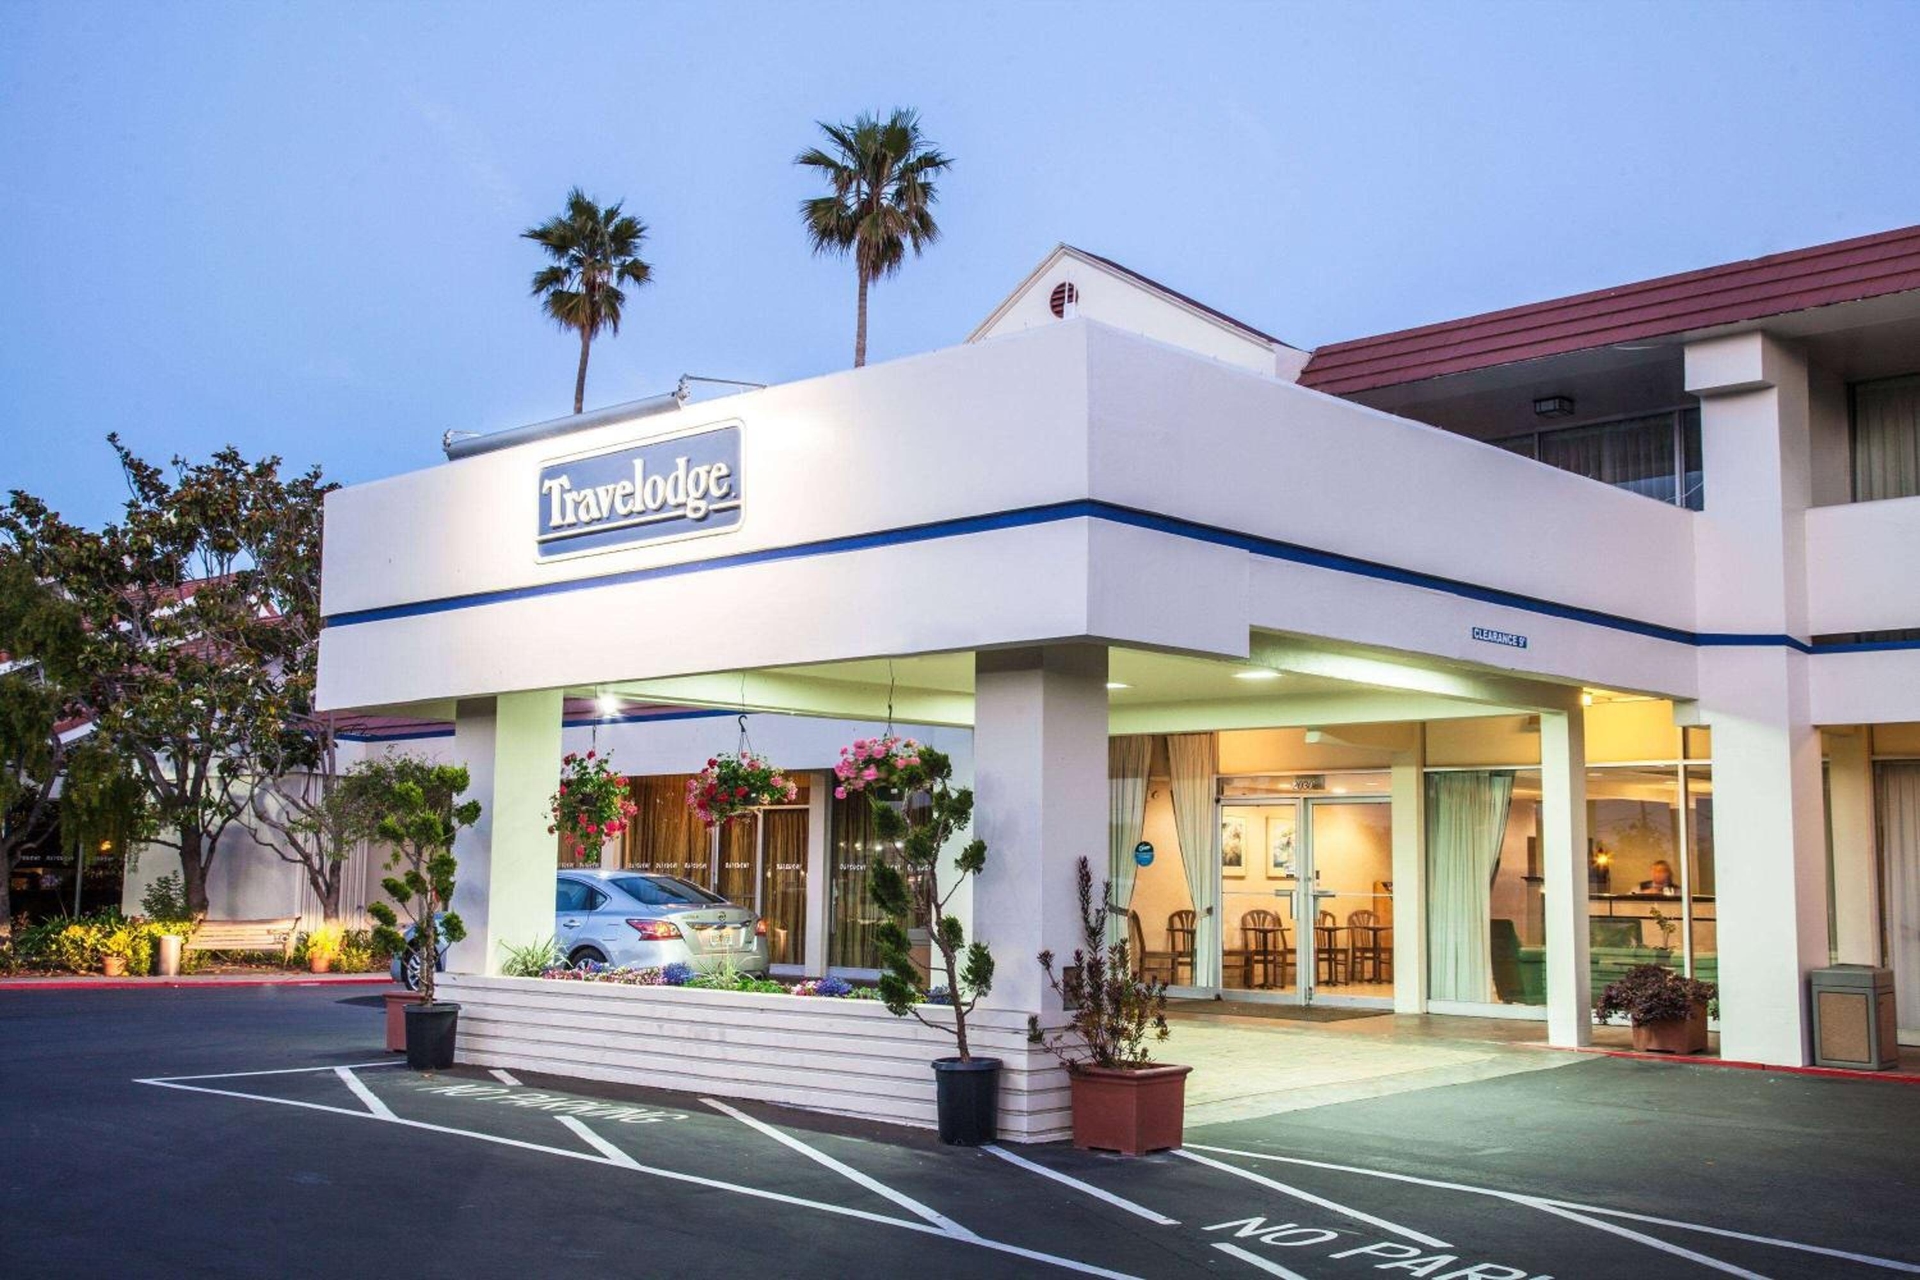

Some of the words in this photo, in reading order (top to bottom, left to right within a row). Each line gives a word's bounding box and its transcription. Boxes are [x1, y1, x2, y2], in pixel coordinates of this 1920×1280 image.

[543, 456, 732, 527] Travelodge
[1474, 628, 1518, 646] CLEARANCE
[475, 1093, 690, 1124] PARKING
[1202, 1216, 1339, 1247] NO
[1328, 1242, 1555, 1280] PAR
